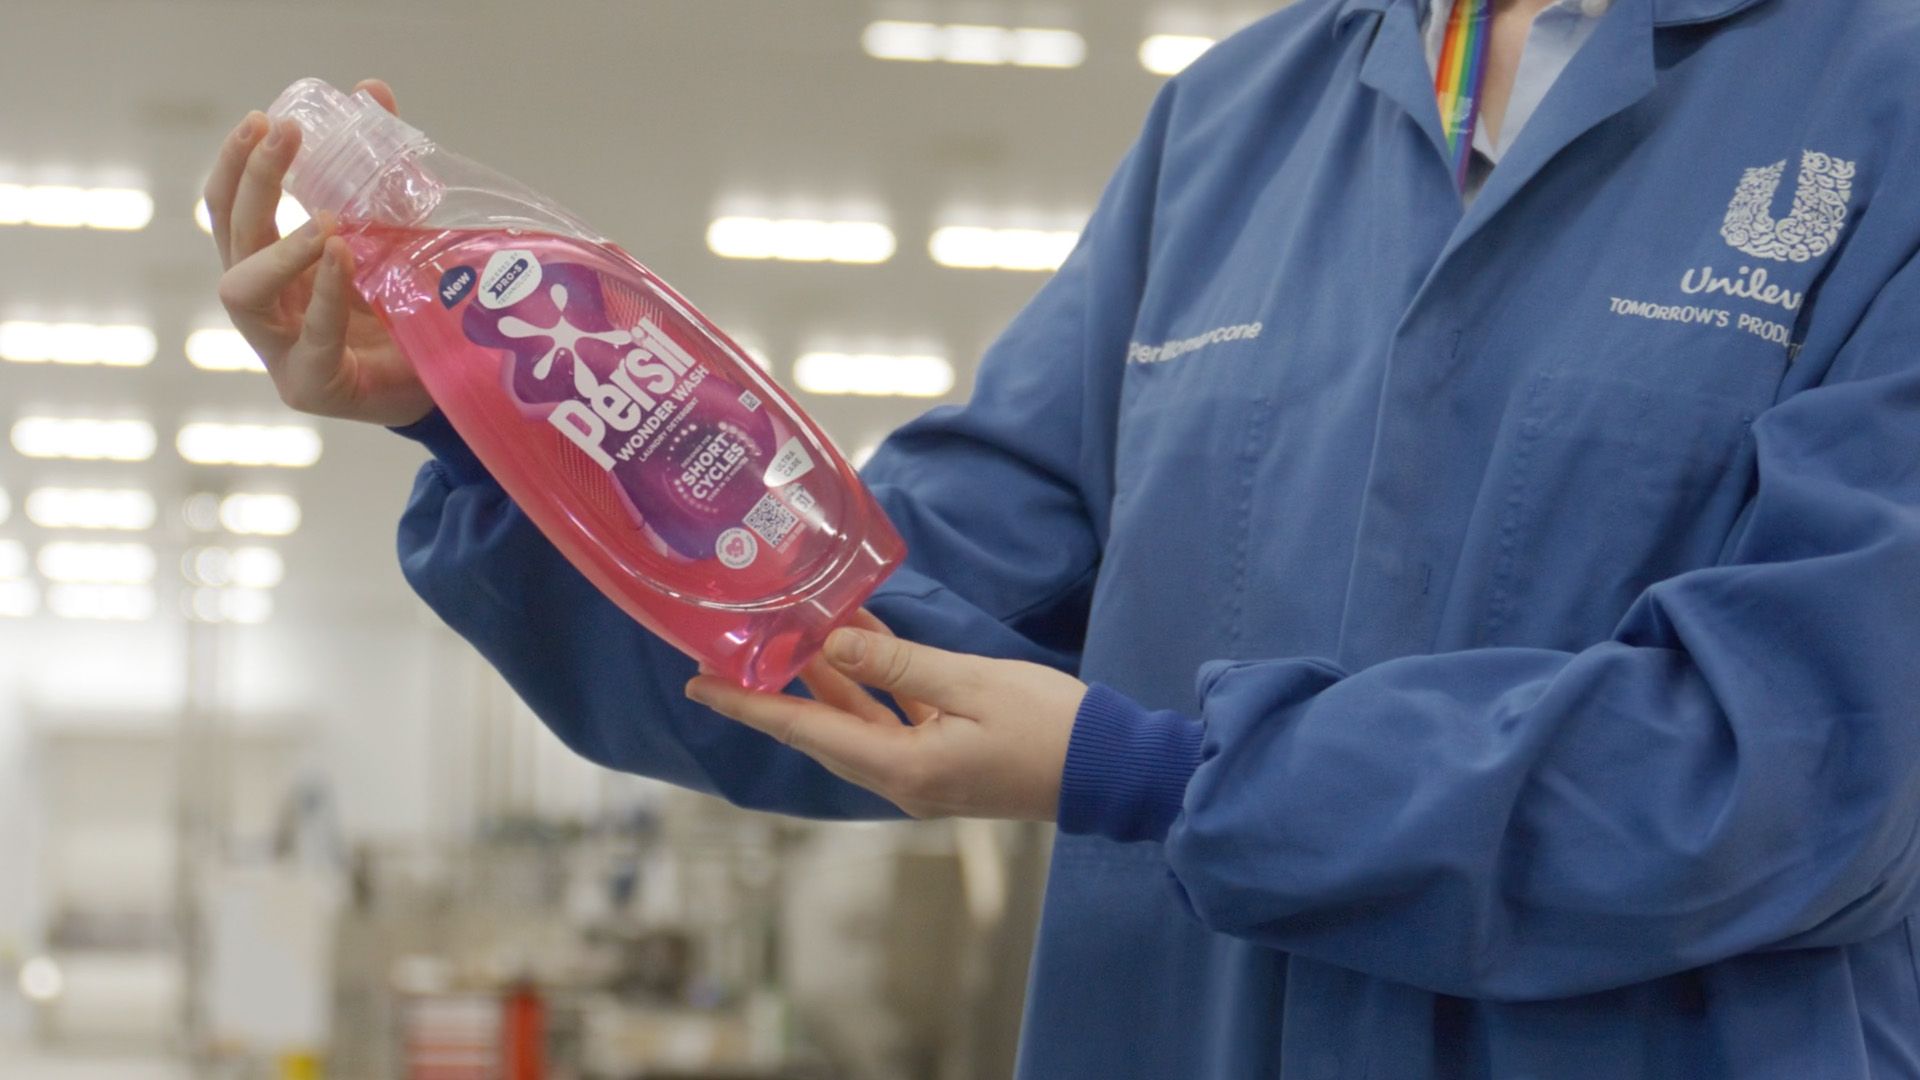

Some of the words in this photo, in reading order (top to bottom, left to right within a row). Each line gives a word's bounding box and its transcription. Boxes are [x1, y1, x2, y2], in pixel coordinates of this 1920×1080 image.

[442, 272, 471, 300] New
[1681, 266, 1801, 309] Unilev
[1610, 297, 1730, 327] TOMORROW'S
[616, 400, 678, 462] WONDER
[671, 364, 709, 402] WASH
[639, 431, 668, 462] LAUNDRY
[666, 396, 700, 433] DETERGENT
[681, 431, 730, 486] SHORT
[691, 442, 746, 500] CYCLES
[774, 450, 796, 472] ULTRA
[783, 457, 802, 477] CARE
